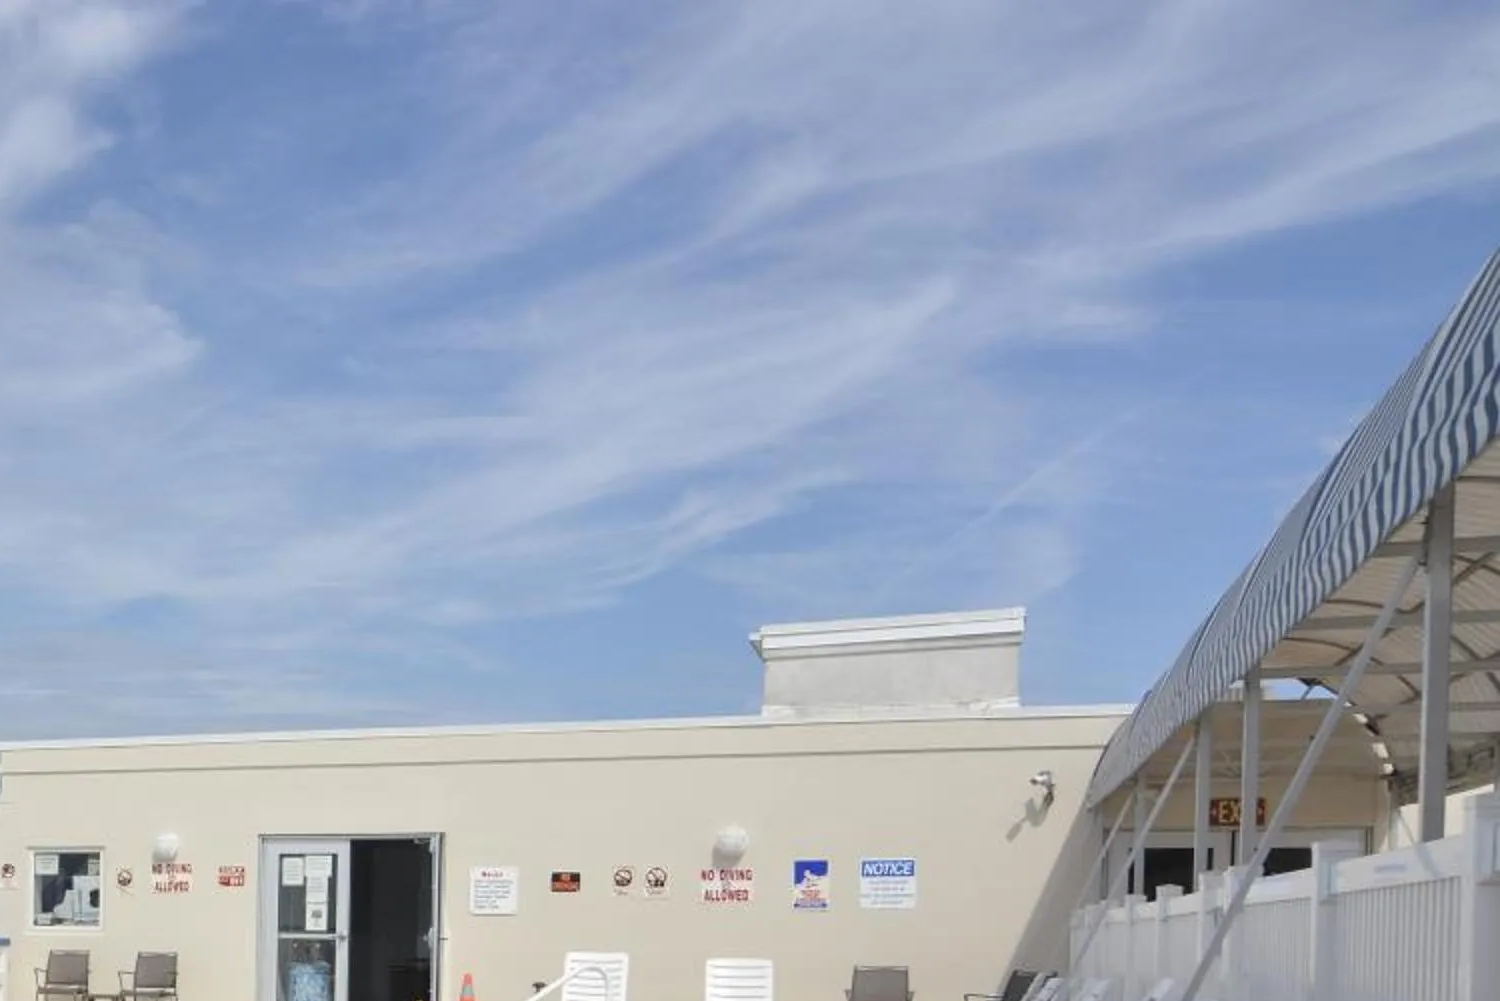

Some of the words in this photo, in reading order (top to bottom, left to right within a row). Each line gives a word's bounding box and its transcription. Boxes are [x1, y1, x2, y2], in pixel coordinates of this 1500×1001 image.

[863, 862, 912, 875] NOTICE
[701, 869, 714, 880] NO
[720, 869, 752, 881] DIVING
[704, 889, 748, 901] ALLOWED
